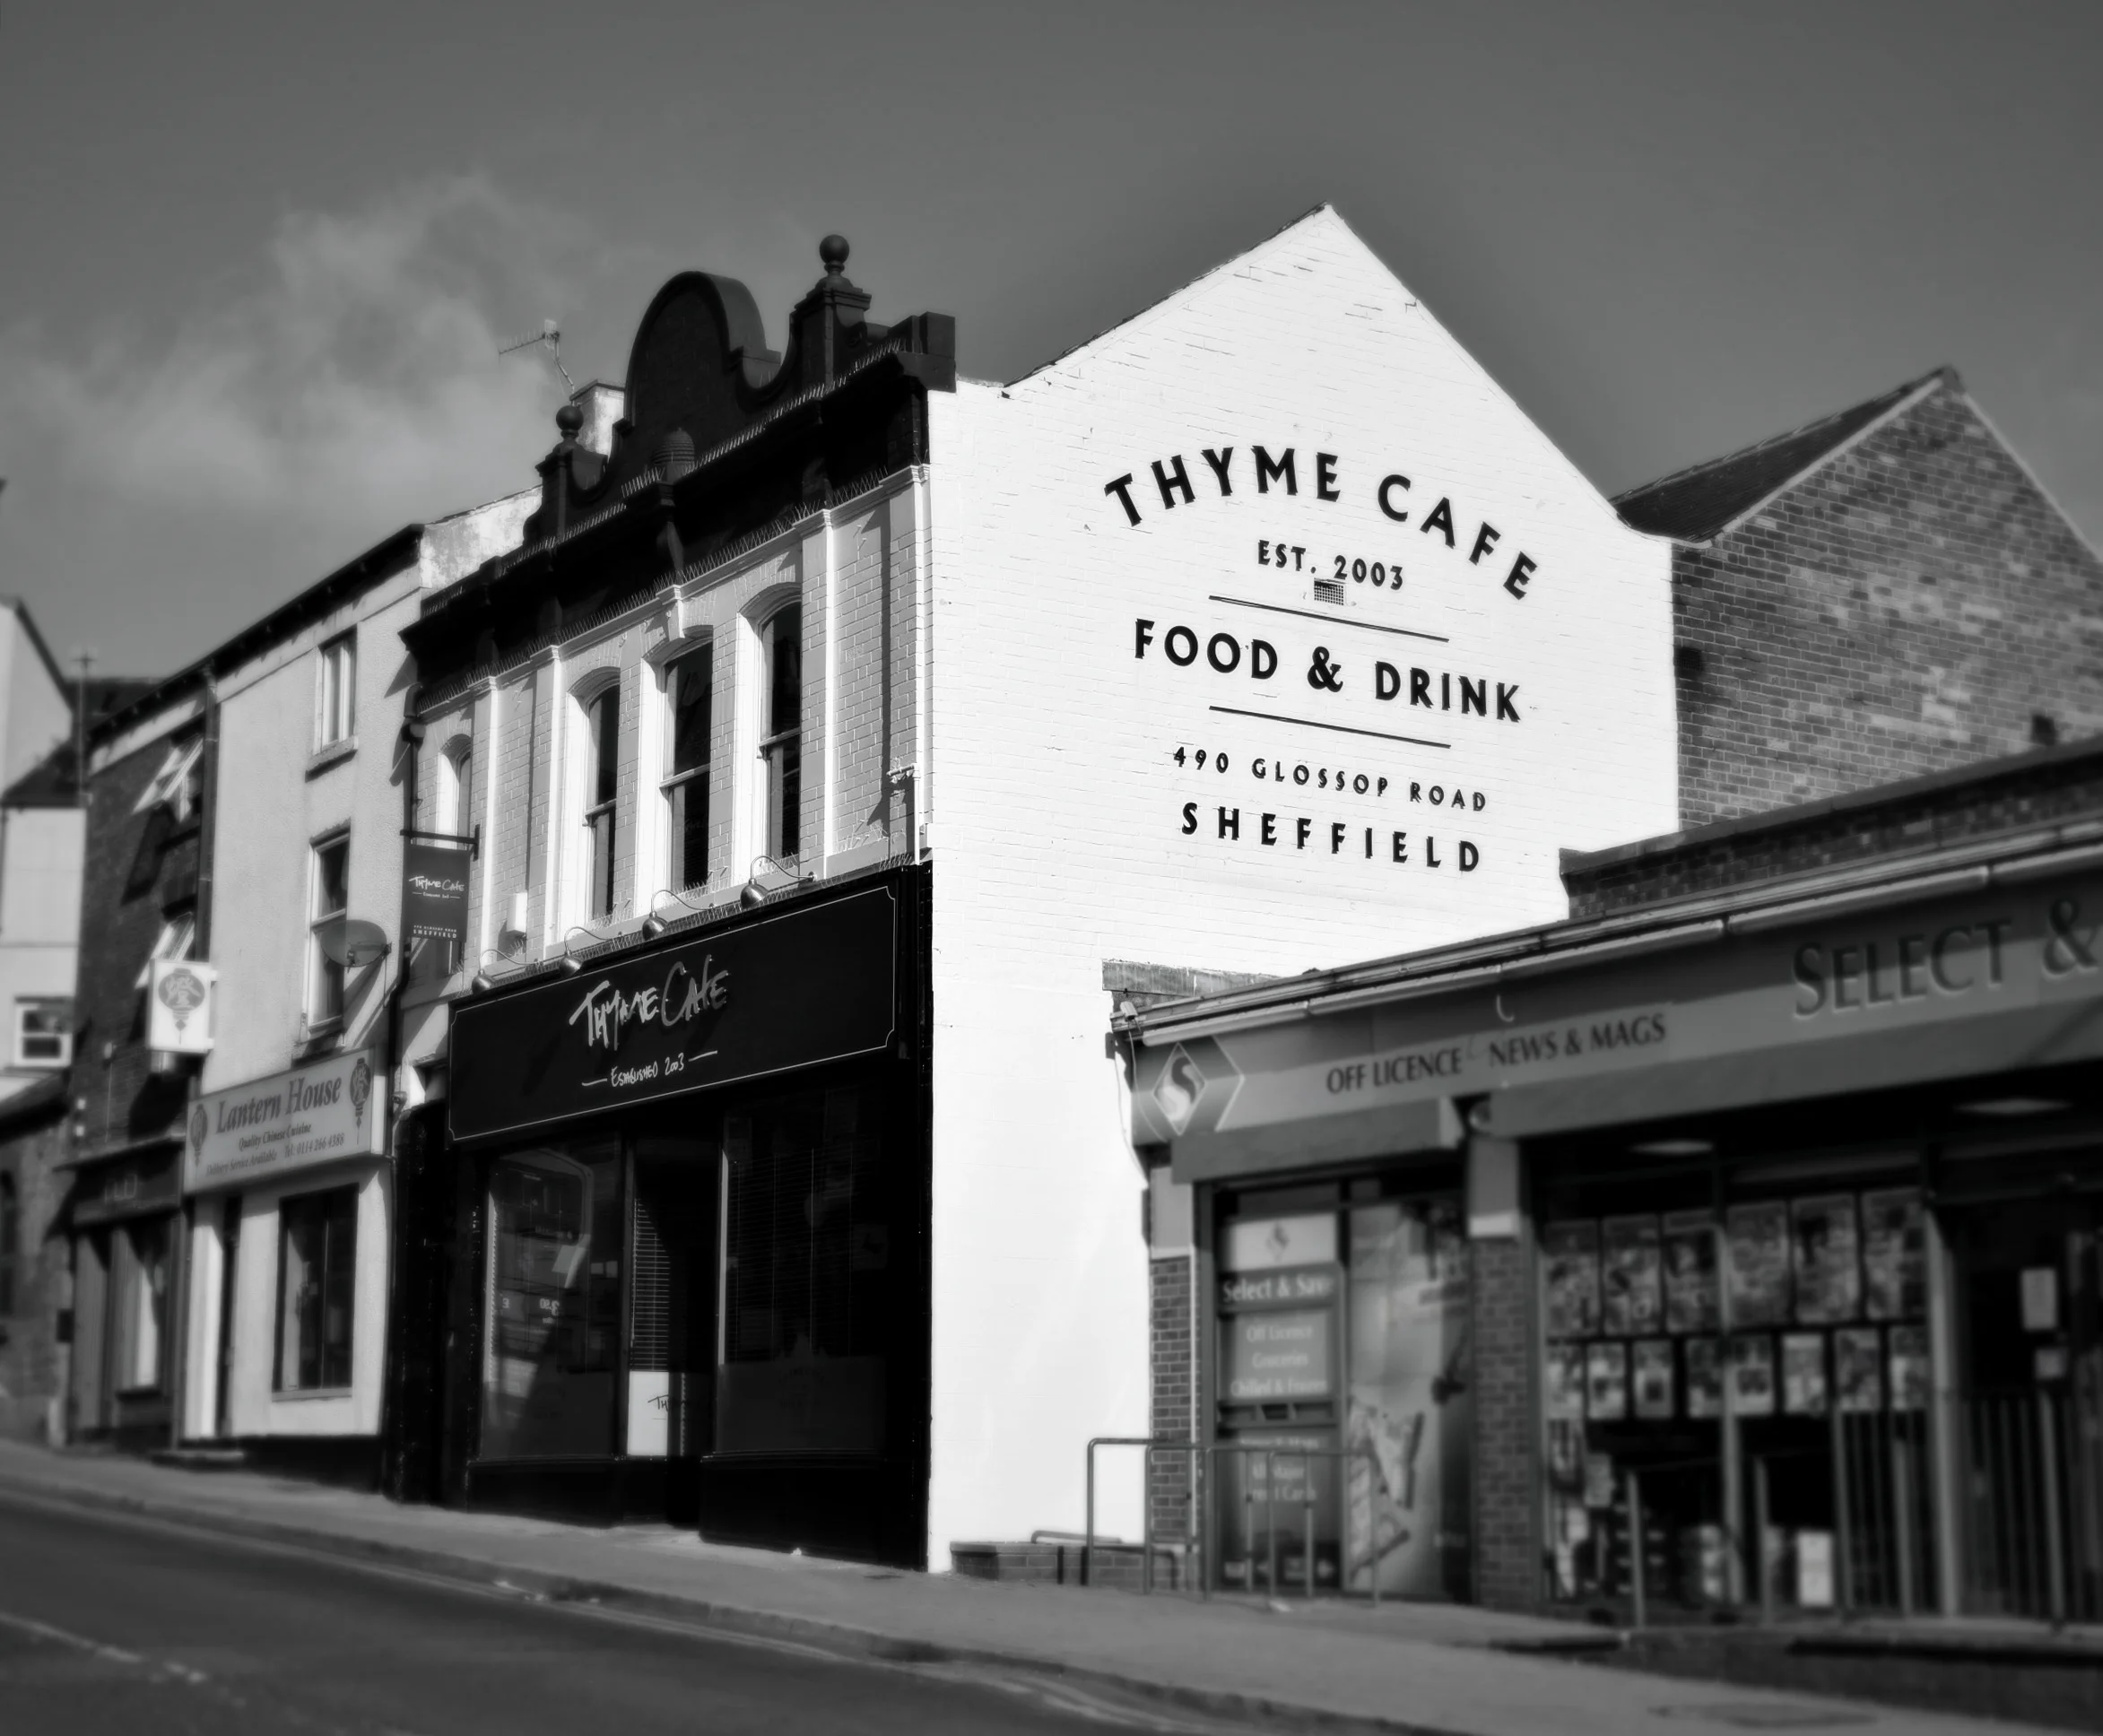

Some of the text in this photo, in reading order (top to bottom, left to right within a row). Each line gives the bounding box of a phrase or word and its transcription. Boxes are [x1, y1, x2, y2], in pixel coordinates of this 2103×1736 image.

[1103, 445, 1538, 600] THYME CAFE
[1257, 539, 1403, 591] EST. 2003
[1134, 618, 1521, 724] FOOD & DRINK
[1173, 746, 1486, 812] 490 GLOSSOP ROAD
[1181, 802, 1480, 872] SHEFFIELD
[413, 929, 457, 939] SHEFFIELD
[1795, 897, 2099, 1018] SELECT &
[665, 1052, 685, 1077] 2003
[1325, 1013, 1667, 1094] OFF LICENCE NEWS & MAGS
[216, 1076, 343, 1134] Lantern House
[239, 1122, 312, 1152] Quality Chinese Cuisine
[1222, 1277, 1272, 1303] Select
[1277, 1274, 1290, 1298] &
